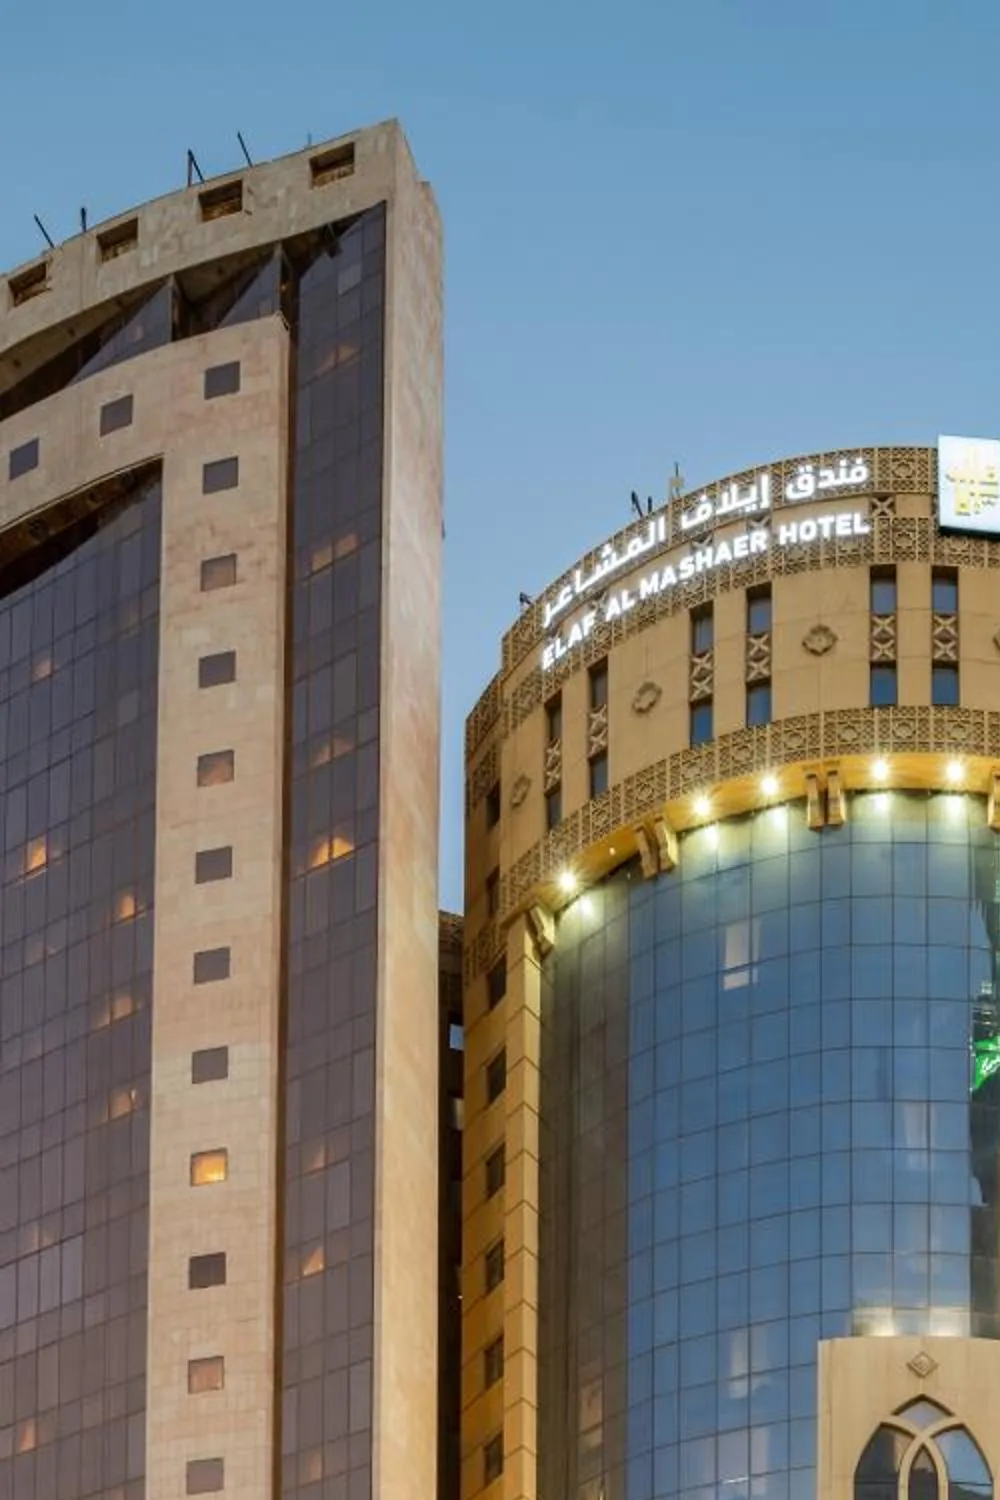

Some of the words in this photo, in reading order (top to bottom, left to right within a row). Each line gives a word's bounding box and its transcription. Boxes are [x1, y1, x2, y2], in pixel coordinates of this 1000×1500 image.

[680, 473, 771, 531] إيلاف
[785, 457, 870, 501] فندق
[541, 609, 598, 671] ELAF
[604, 588, 636, 622] AL
[638, 529, 771, 600] MASHAER
[778, 512, 872, 545] HOTEL
[542, 515, 667, 629] المشاعر
